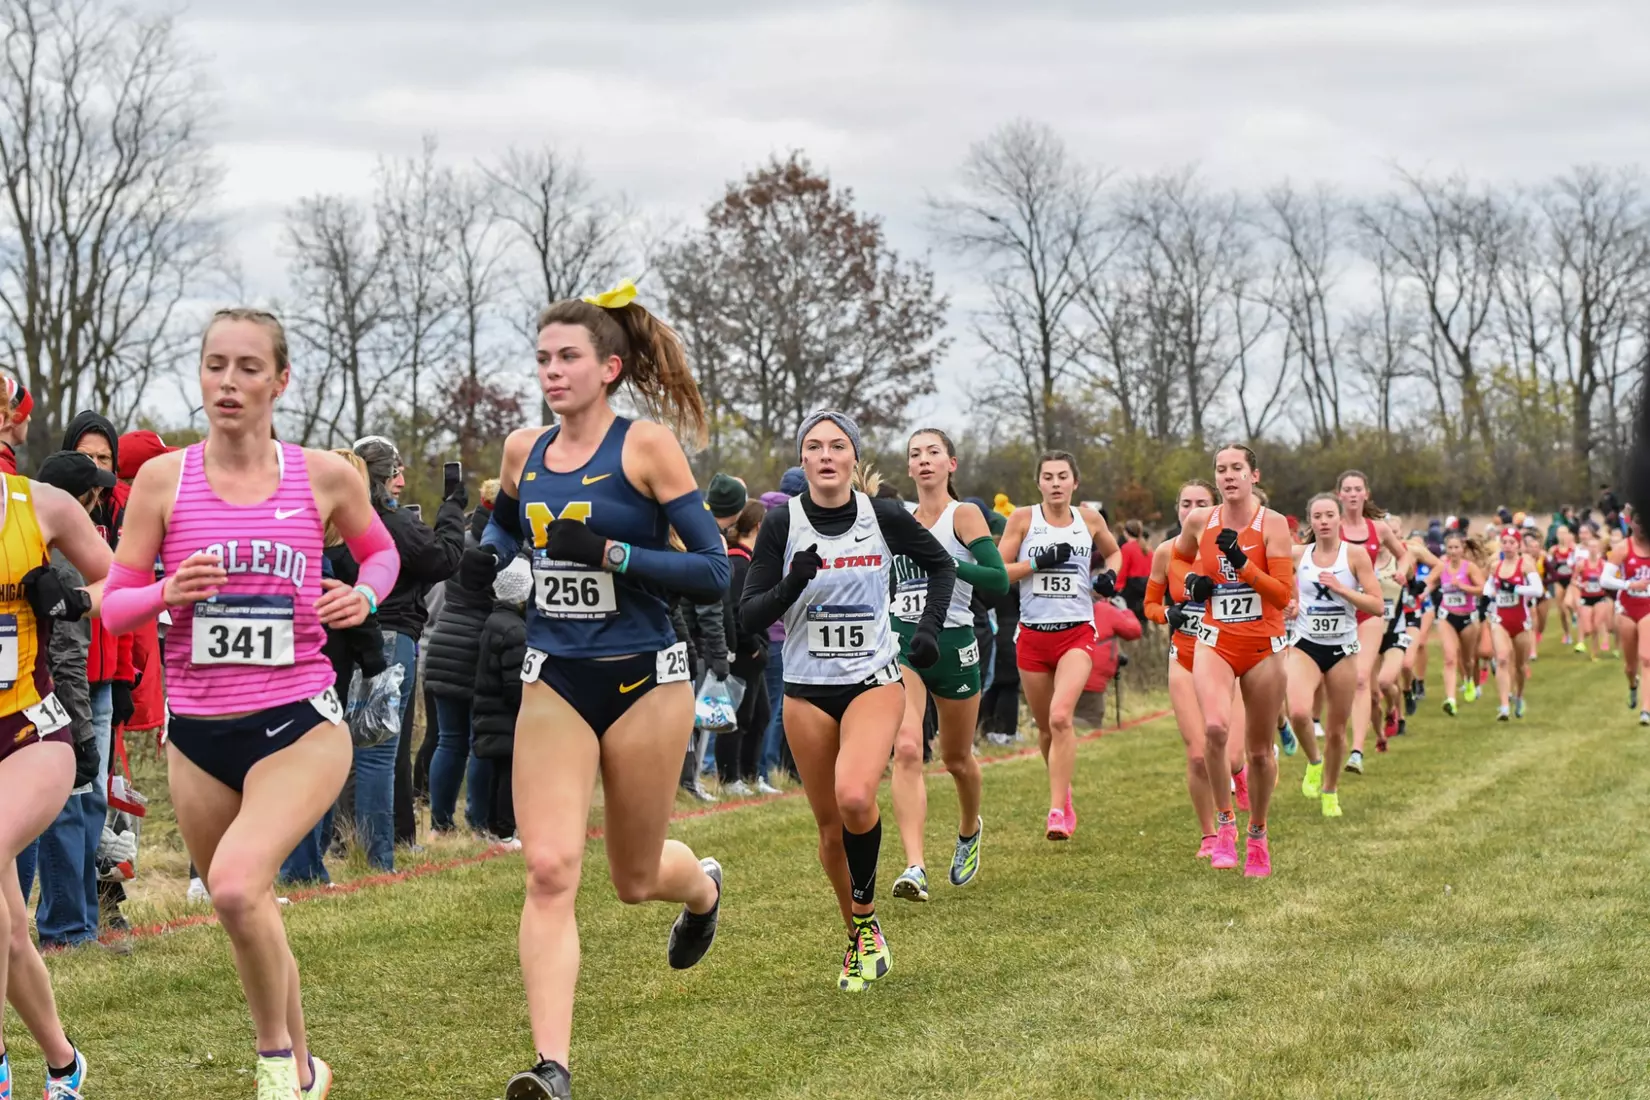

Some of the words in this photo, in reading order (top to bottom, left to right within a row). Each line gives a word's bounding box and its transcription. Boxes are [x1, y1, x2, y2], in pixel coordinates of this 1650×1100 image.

[187, 540, 307, 588] OLEDO
[834, 555, 882, 569] STATE
[544, 576, 600, 606] 256
[1041, 576, 1071, 591] 153
[1311, 582, 1334, 601] X
[902, 594, 927, 613] 31
[1220, 597, 1253, 615] 127
[1036, 623, 1067, 632] NIKE
[1312, 618, 1339, 632] 397
[208, 625, 273, 659] 341
[819, 625, 864, 648] 115
